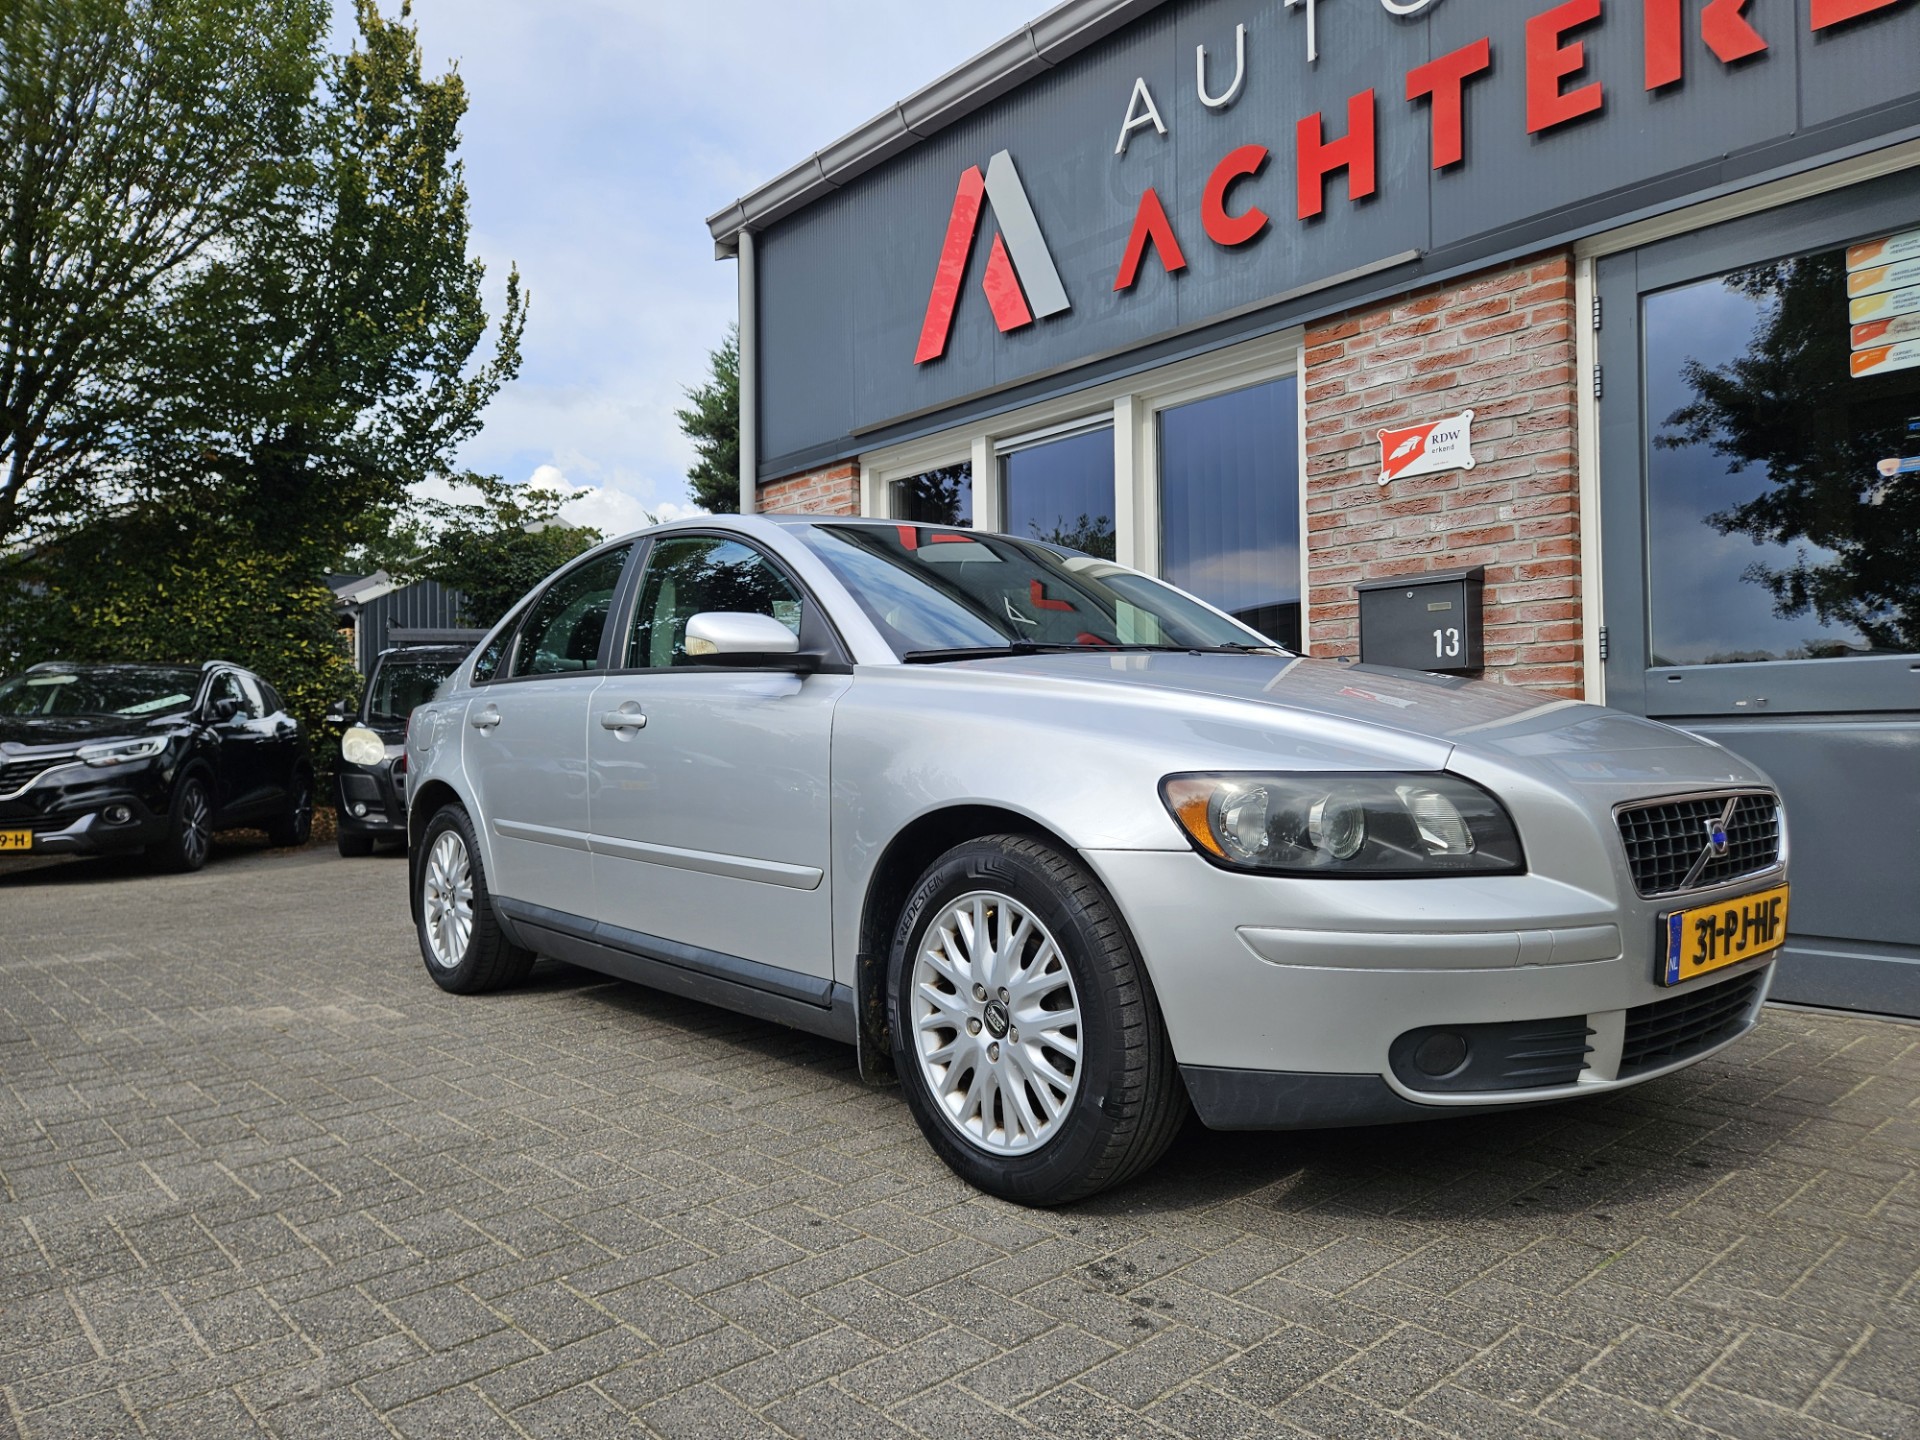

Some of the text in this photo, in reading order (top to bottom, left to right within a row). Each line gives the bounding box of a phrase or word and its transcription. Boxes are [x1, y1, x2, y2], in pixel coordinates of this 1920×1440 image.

[1115, 0, 1431, 154] AUT
[1113, 0, 1898, 291] ACHTER
[1432, 430, 1460, 444] RDW
[1432, 444, 1454, 453] erkend
[1433, 628, 1460, 658] 13
[896, 872, 945, 946] VREDESTEIN
[1692, 897, 1782, 966] 31-PJ-HF
[1668, 957, 1678, 970] NL
